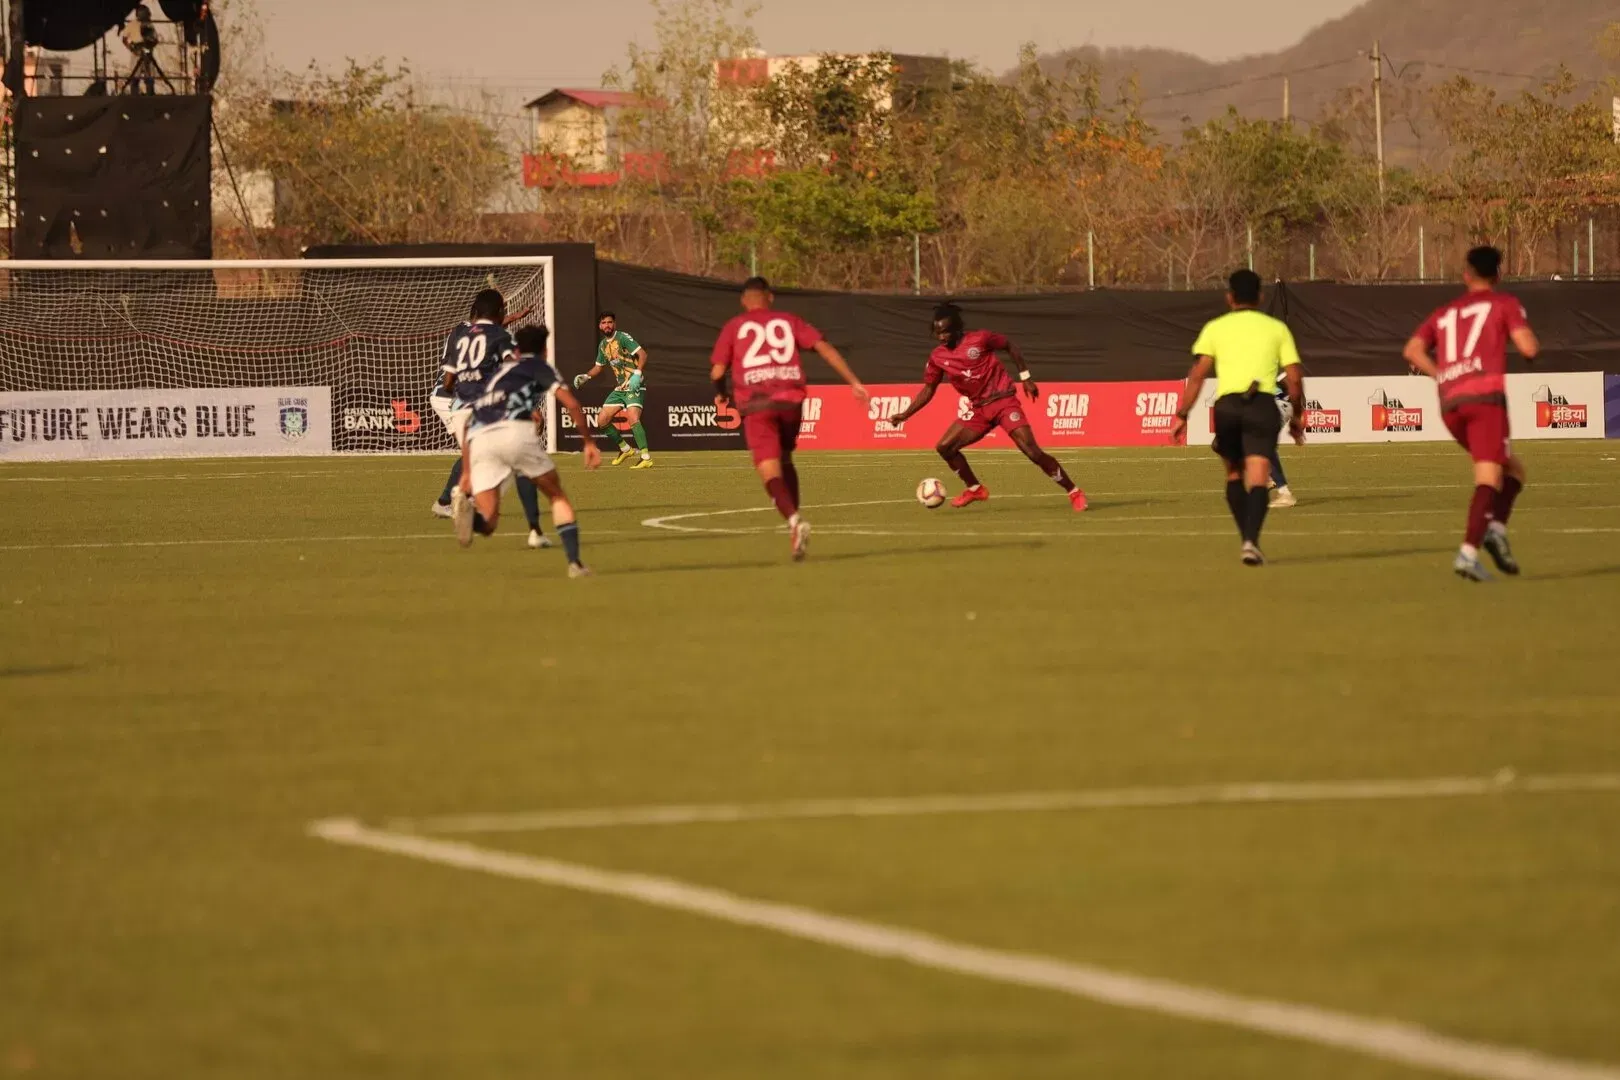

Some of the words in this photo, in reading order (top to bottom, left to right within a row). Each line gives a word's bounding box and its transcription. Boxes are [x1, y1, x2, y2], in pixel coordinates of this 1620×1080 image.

[1437, 301, 1492, 363] 17
[737, 318, 795, 368] 29
[456, 335, 487, 371] 20
[668, 405, 716, 413] RAJASTHAN
[802, 397, 822, 420] AR
[1047, 393, 1089, 417] STAR
[1135, 392, 1178, 416] STAR
[561, 414, 598, 428] BN
[668, 413, 718, 427] BANK
[1142, 416, 1172, 428] CEMENT
[1307, 410, 1339, 427] इंडिया
[1388, 409, 1420, 425] इंडिया
[1553, 406, 1585, 422] इंडिया
[0, 408, 89, 441] FUTURE
[97, 406, 187, 440] WEARS
[196, 405, 256, 438] BLUE
[344, 415, 395, 430] BANK
[799, 422, 816, 432] ENT
[1053, 418, 1083, 429] CEMENT
